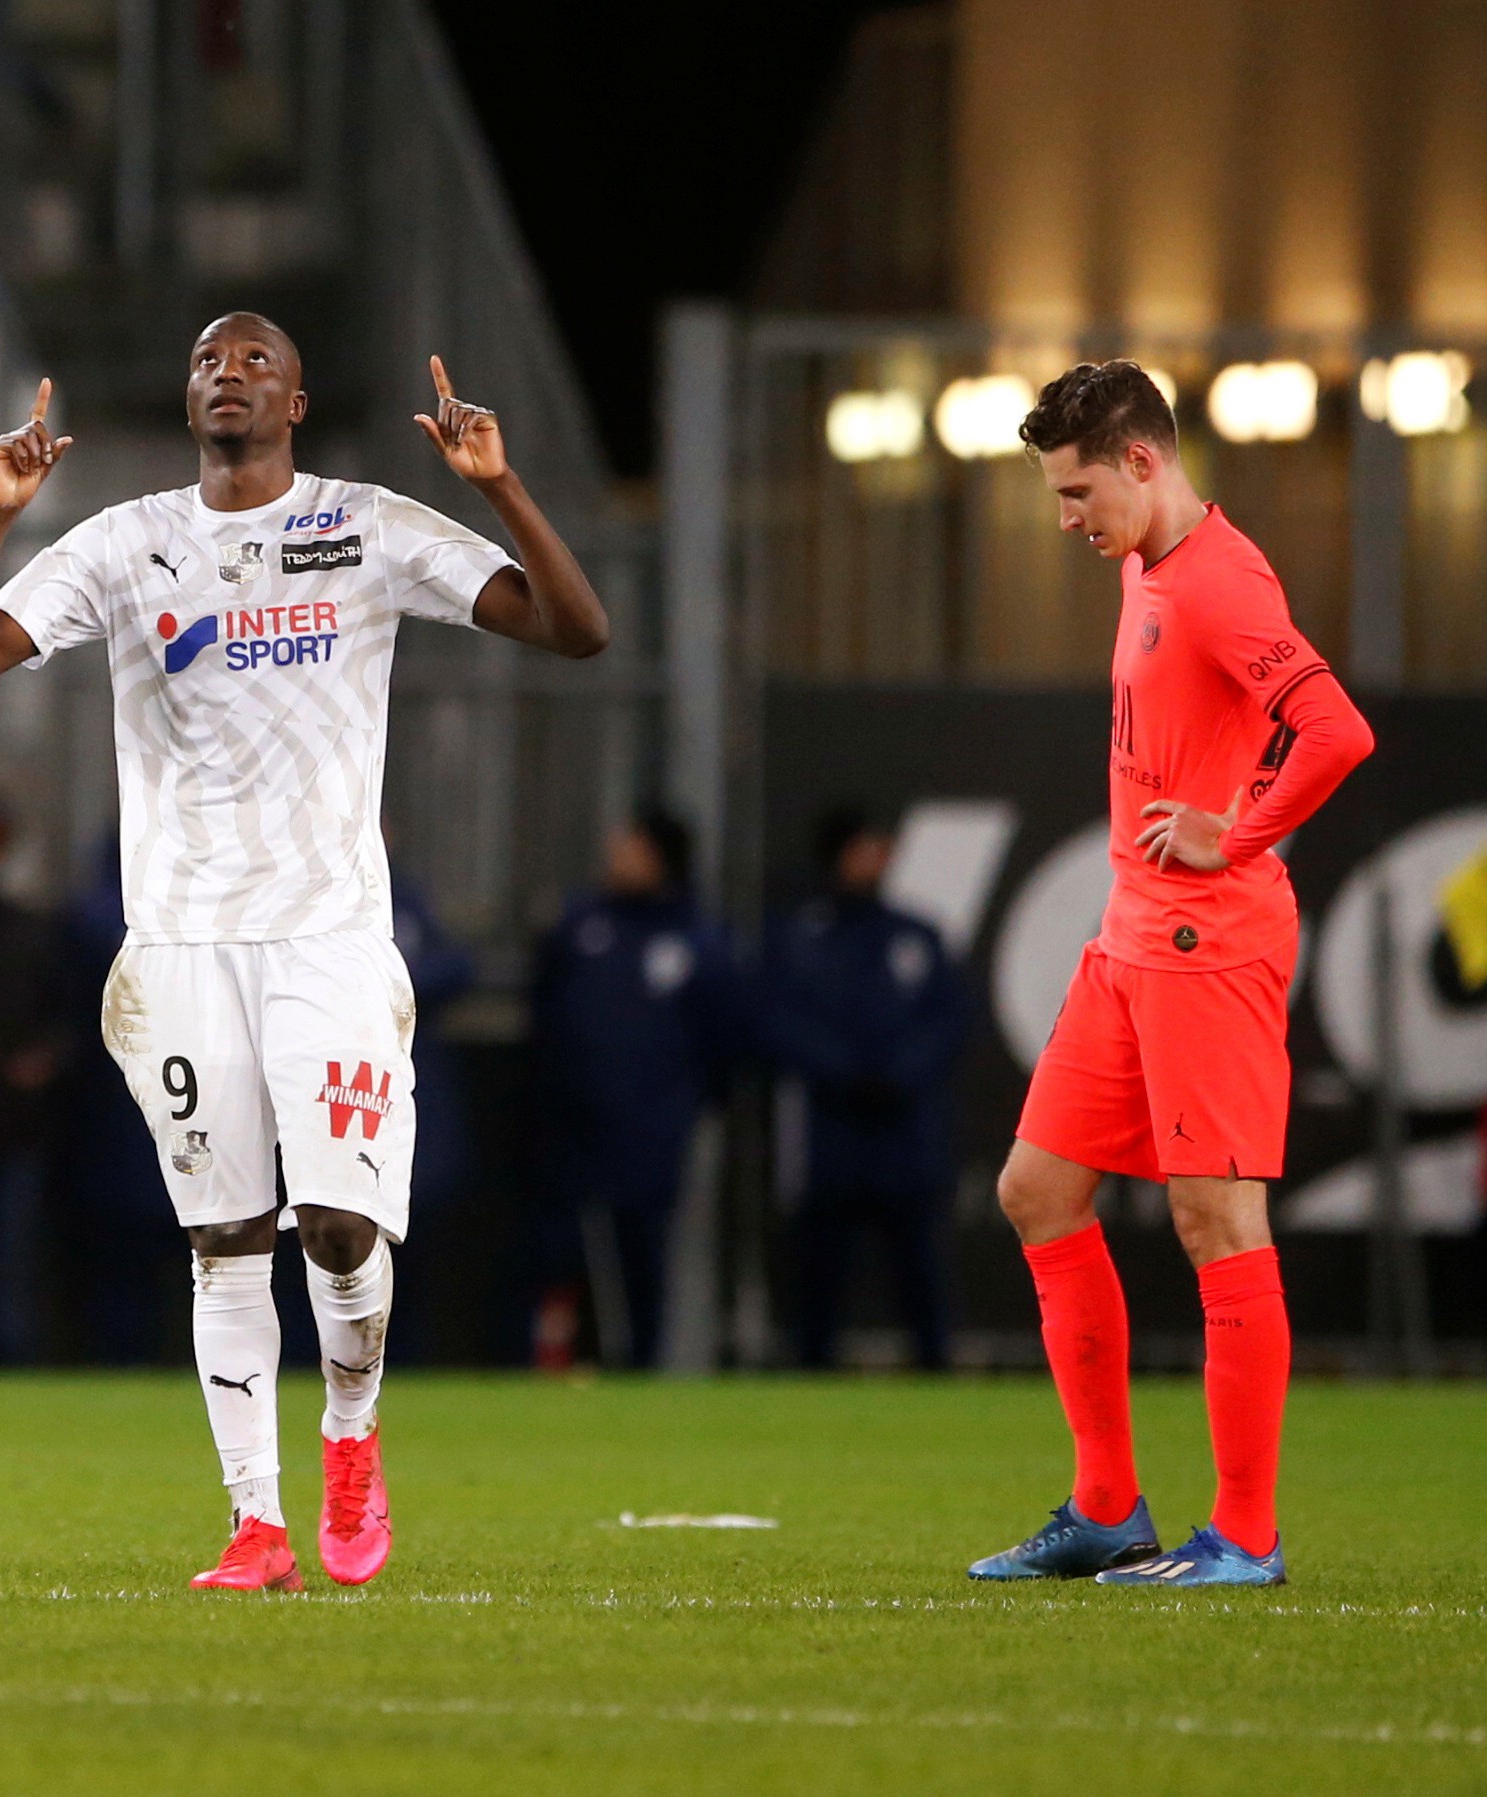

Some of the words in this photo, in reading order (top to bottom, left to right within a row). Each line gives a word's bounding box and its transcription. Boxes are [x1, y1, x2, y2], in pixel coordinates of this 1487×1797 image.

[284, 507, 346, 532] IGOL
[226, 602, 338, 639] INTER
[226, 634, 338, 670] SPORT
[1247, 640, 1297, 682] QNB
[162, 1056, 199, 1121] 9
[323, 1084, 389, 1116] WINAMAX
